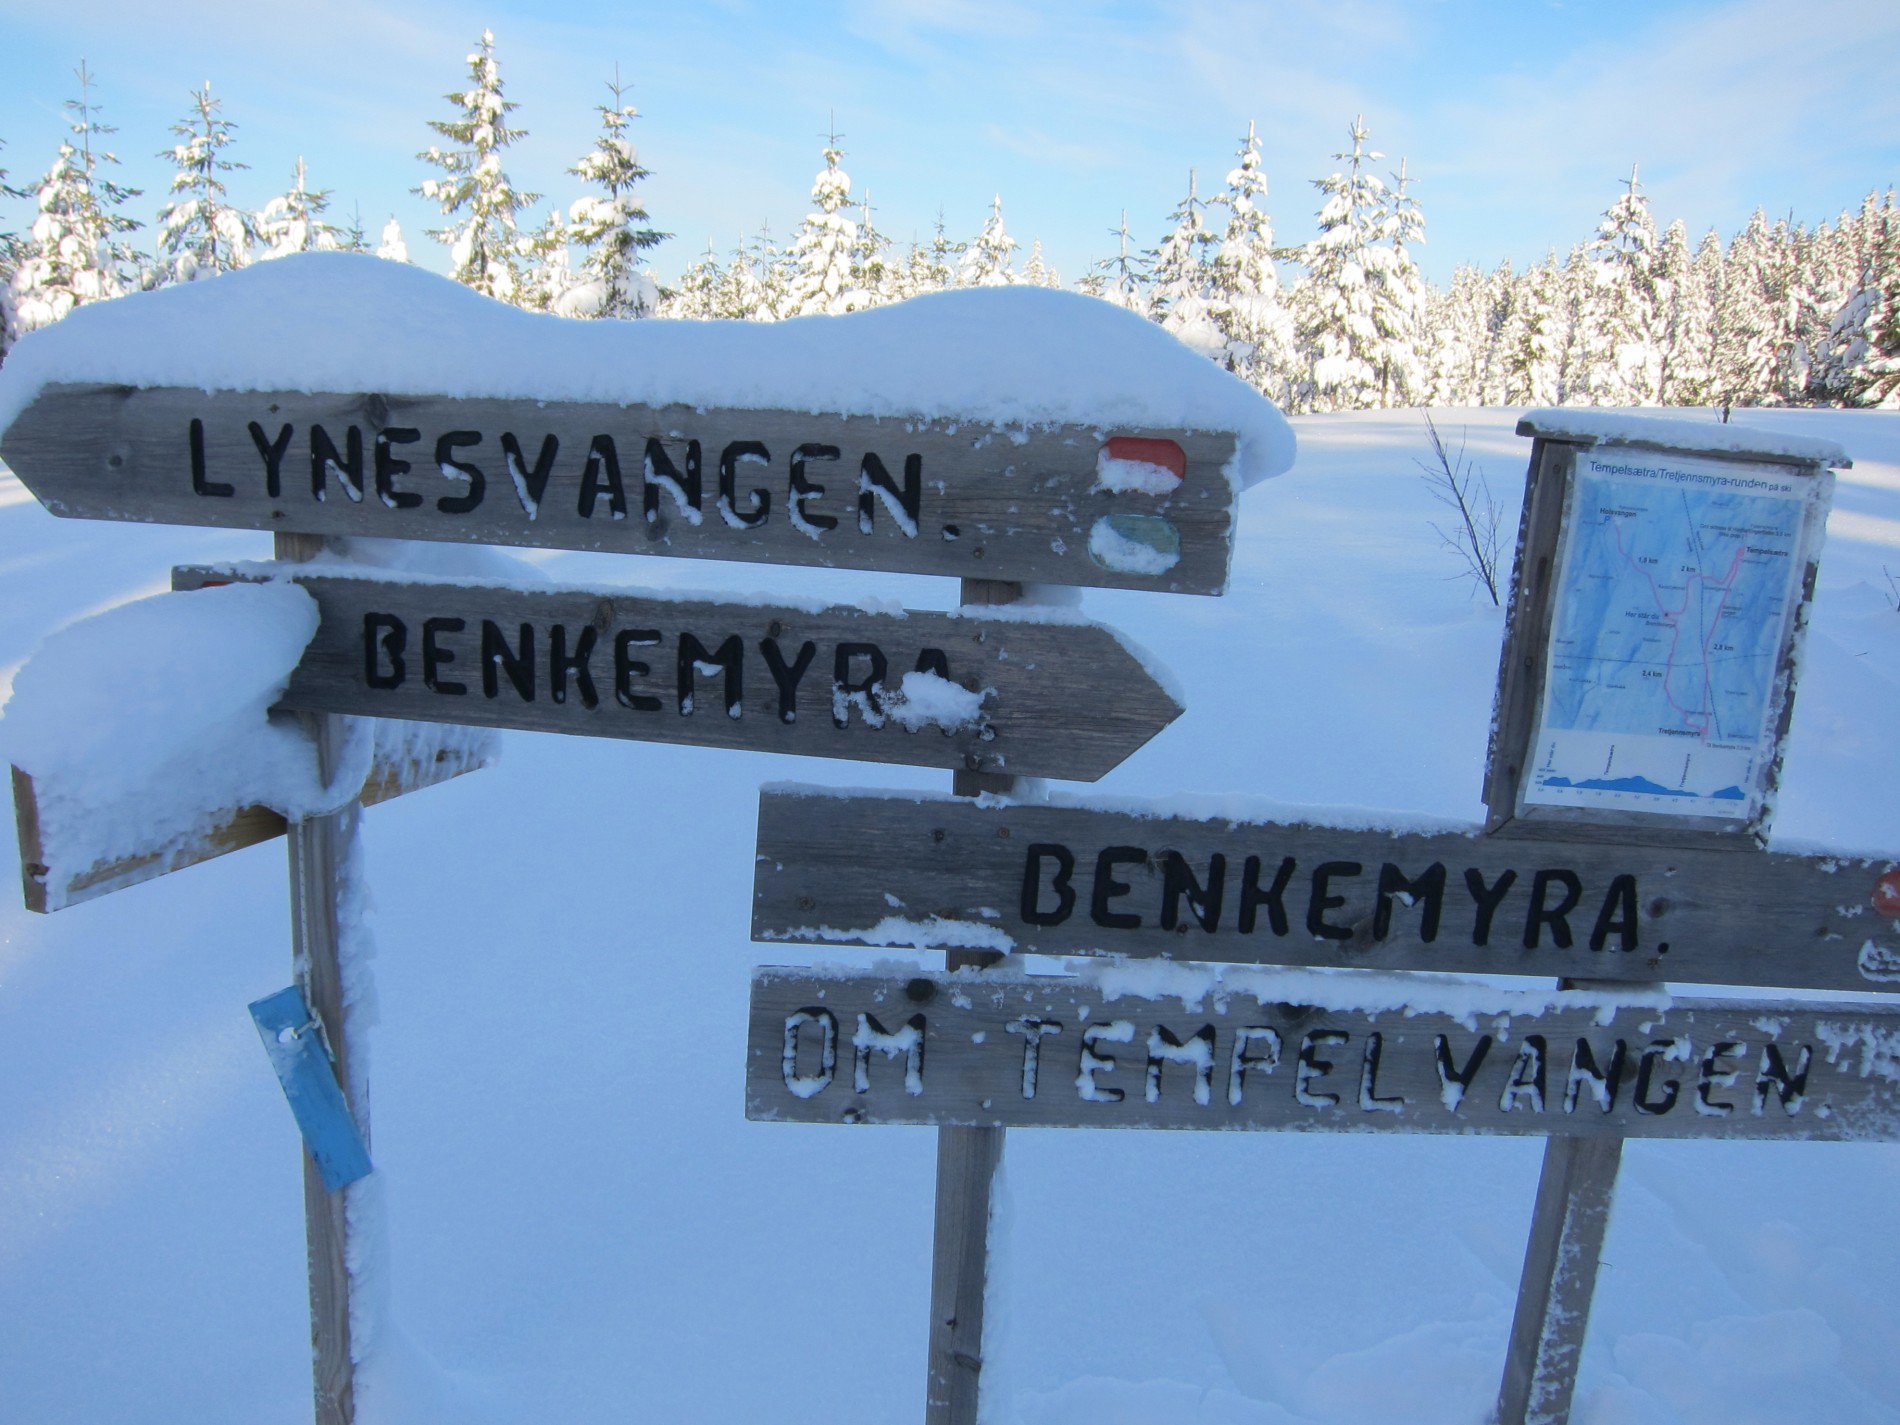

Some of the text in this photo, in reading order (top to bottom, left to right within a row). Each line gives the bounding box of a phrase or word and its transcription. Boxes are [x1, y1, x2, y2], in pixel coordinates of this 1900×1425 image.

[190, 418, 960, 541] LYNESVANGEN.
[1780, 484, 1792, 493] ski
[1686, 565, 1696, 573] km
[1020, 843, 1670, 954] BENKEMYRA.
[782, 1006, 926, 1099] OM
